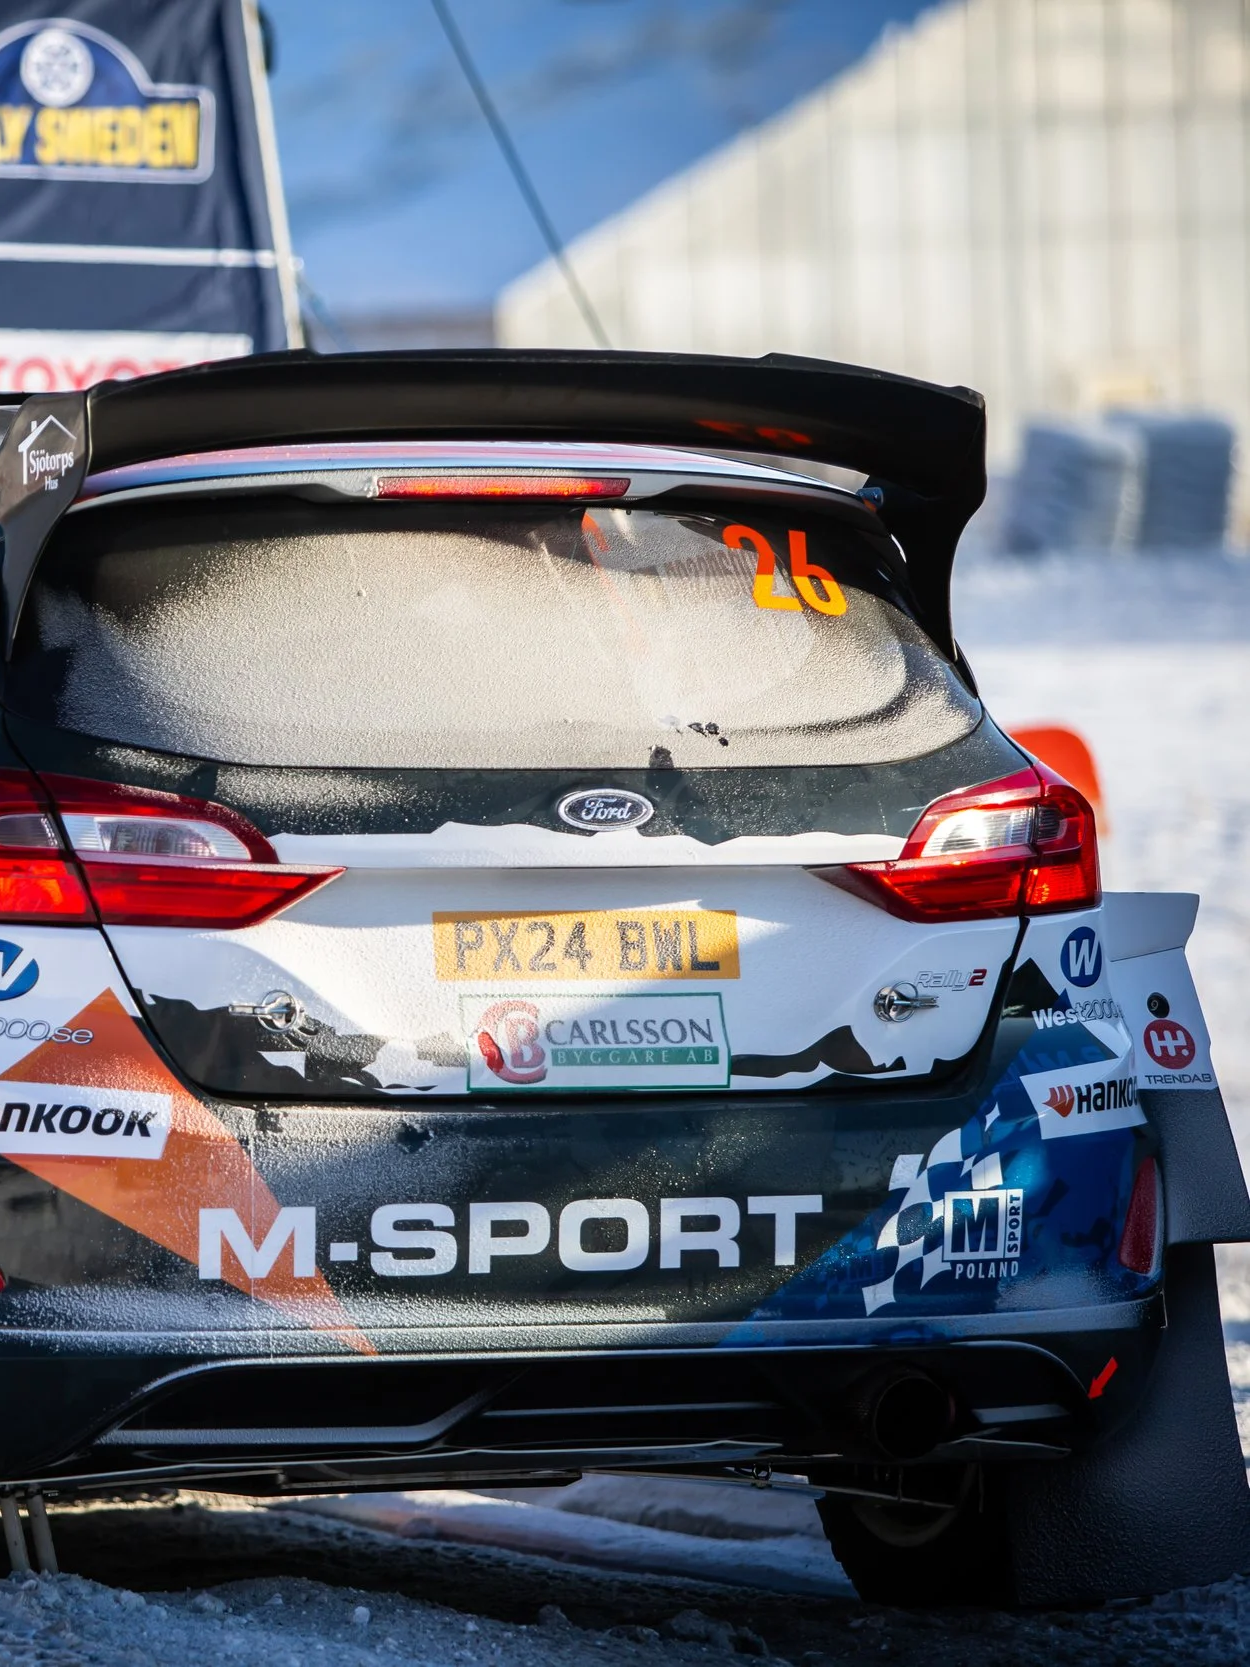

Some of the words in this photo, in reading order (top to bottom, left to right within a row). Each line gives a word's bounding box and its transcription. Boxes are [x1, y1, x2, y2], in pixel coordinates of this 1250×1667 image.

[35, 101, 200, 169] SWEDEN
[29, 449, 74, 480] Sjötorps
[44, 476, 59, 491] Hus
[722, 524, 847, 616] 26
[581, 797, 632, 822] Ford
[454, 920, 593, 973] PX24
[616, 920, 720, 972] BWL
[916, 968, 987, 992] Rally2
[545, 1018, 714, 1046] CARLSSON
[558, 1050, 670, 1064] BYGGARE
[686, 1049, 713, 1063] AB
[1145, 1073, 1213, 1085] TRENDAB
[198, 1194, 823, 1280] M-SPORT
[951, 1197, 999, 1253] M
[1007, 1194, 1021, 1253] SPORT
[955, 1260, 1019, 1280] POLAND
